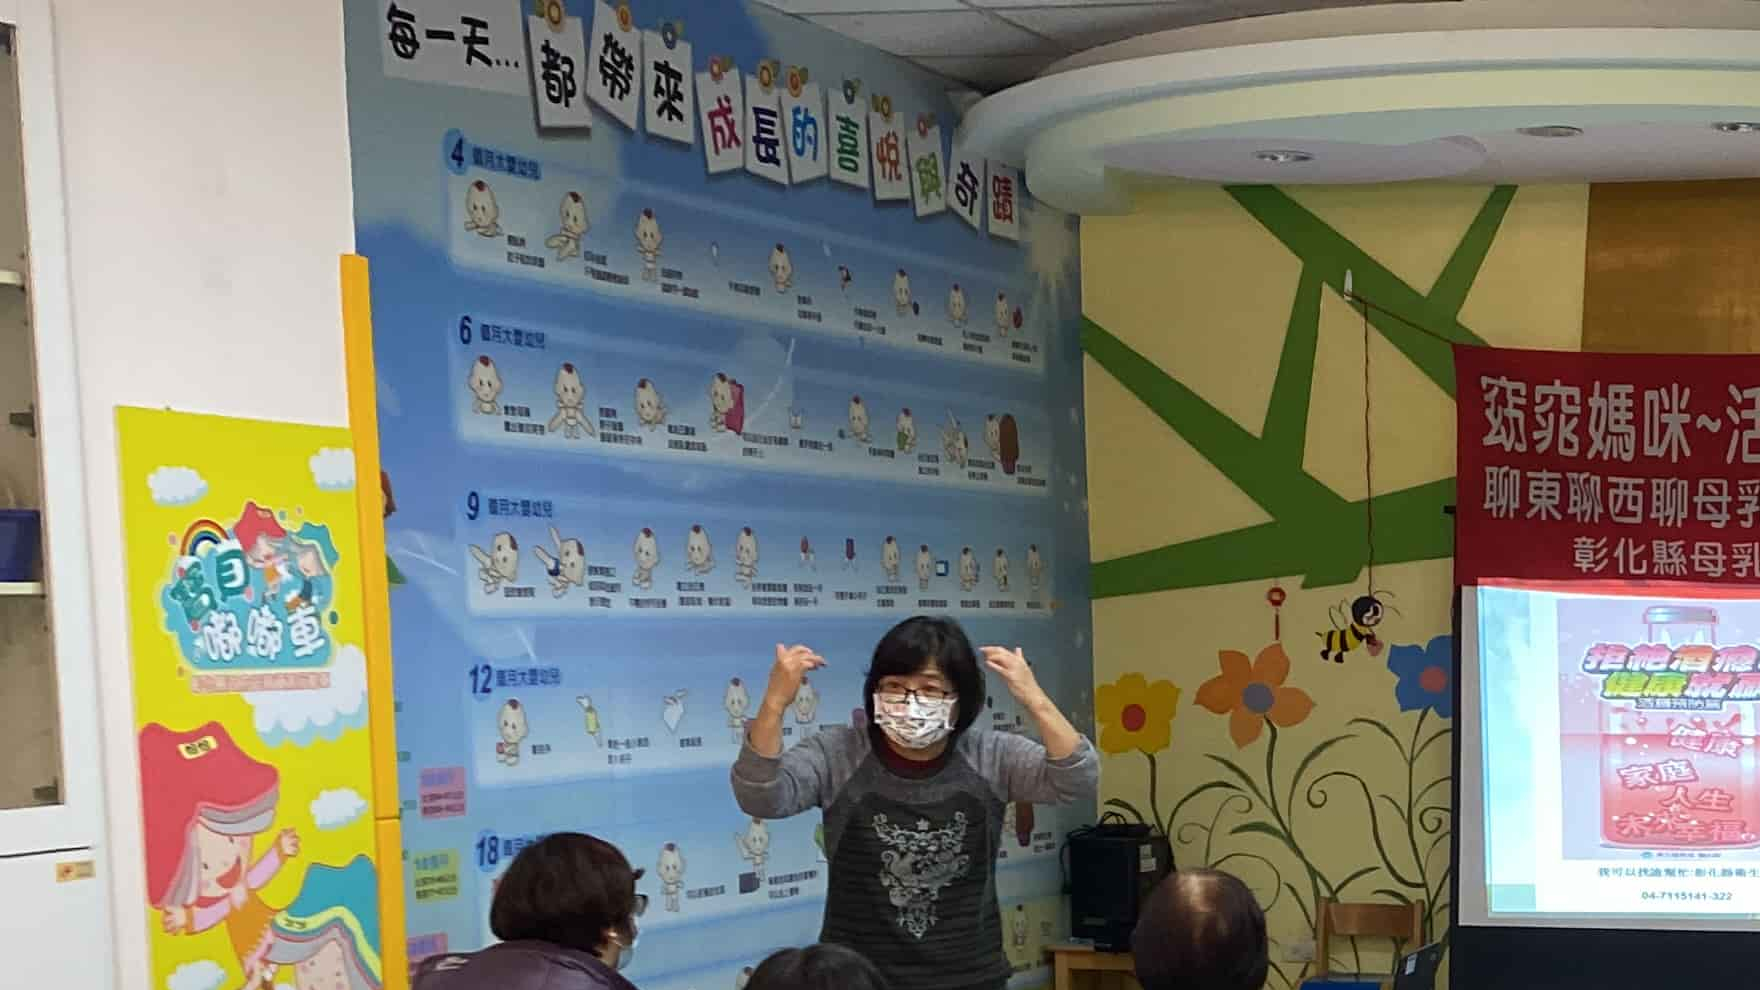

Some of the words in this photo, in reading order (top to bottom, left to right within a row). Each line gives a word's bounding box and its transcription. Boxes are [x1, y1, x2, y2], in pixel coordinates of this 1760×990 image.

[451, 138, 465, 168] 4
[459, 315, 473, 345] 6
[466, 491, 480, 520] 9
[470, 664, 493, 694] 12
[1669, 724, 1744, 758] 健康
[1617, 759, 1698, 789] 家庭
[1660, 785, 1735, 813] 人生
[1673, 819, 1747, 842] 幸福
[476, 834, 499, 867] 18
